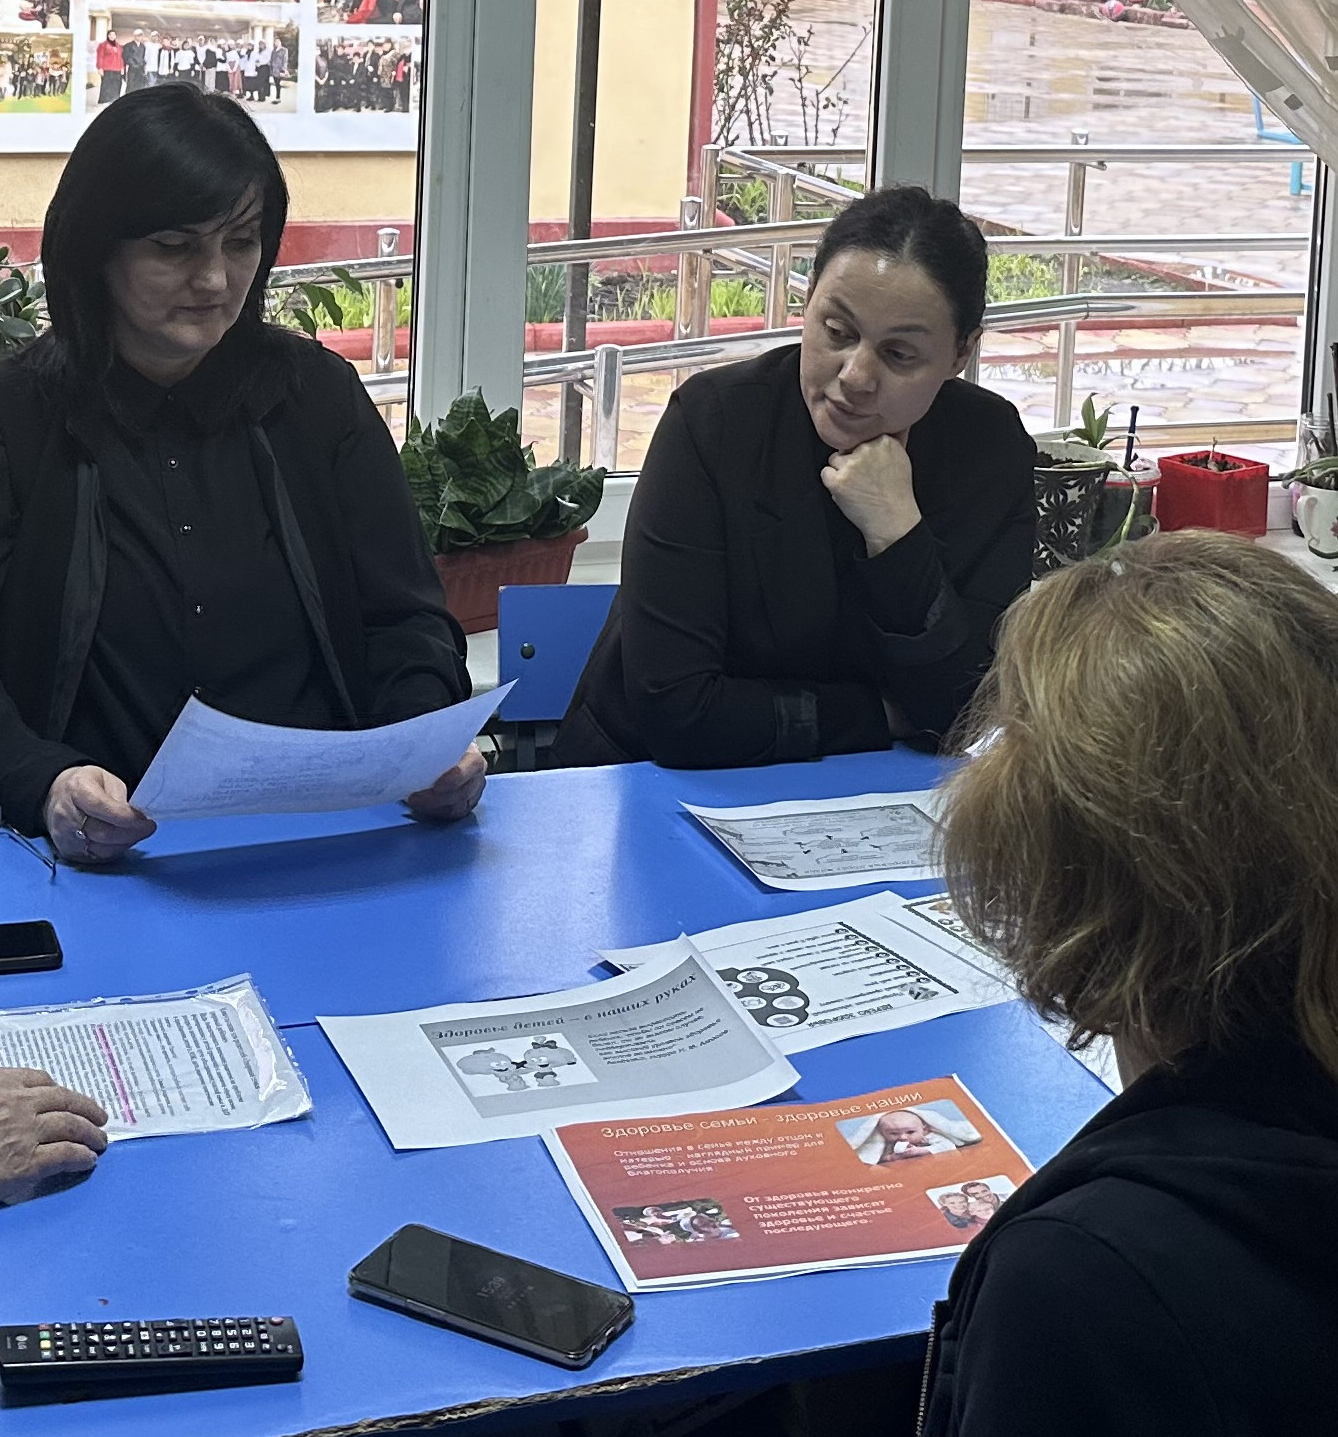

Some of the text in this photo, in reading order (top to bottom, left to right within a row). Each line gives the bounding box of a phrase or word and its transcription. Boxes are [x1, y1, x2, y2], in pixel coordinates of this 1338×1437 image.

[601, 1120, 694, 1139] Здоровье
[699, 1114, 759, 1130] семьи
[774, 1103, 862, 1124] здоровье
[866, 1091, 923, 1112] нации
